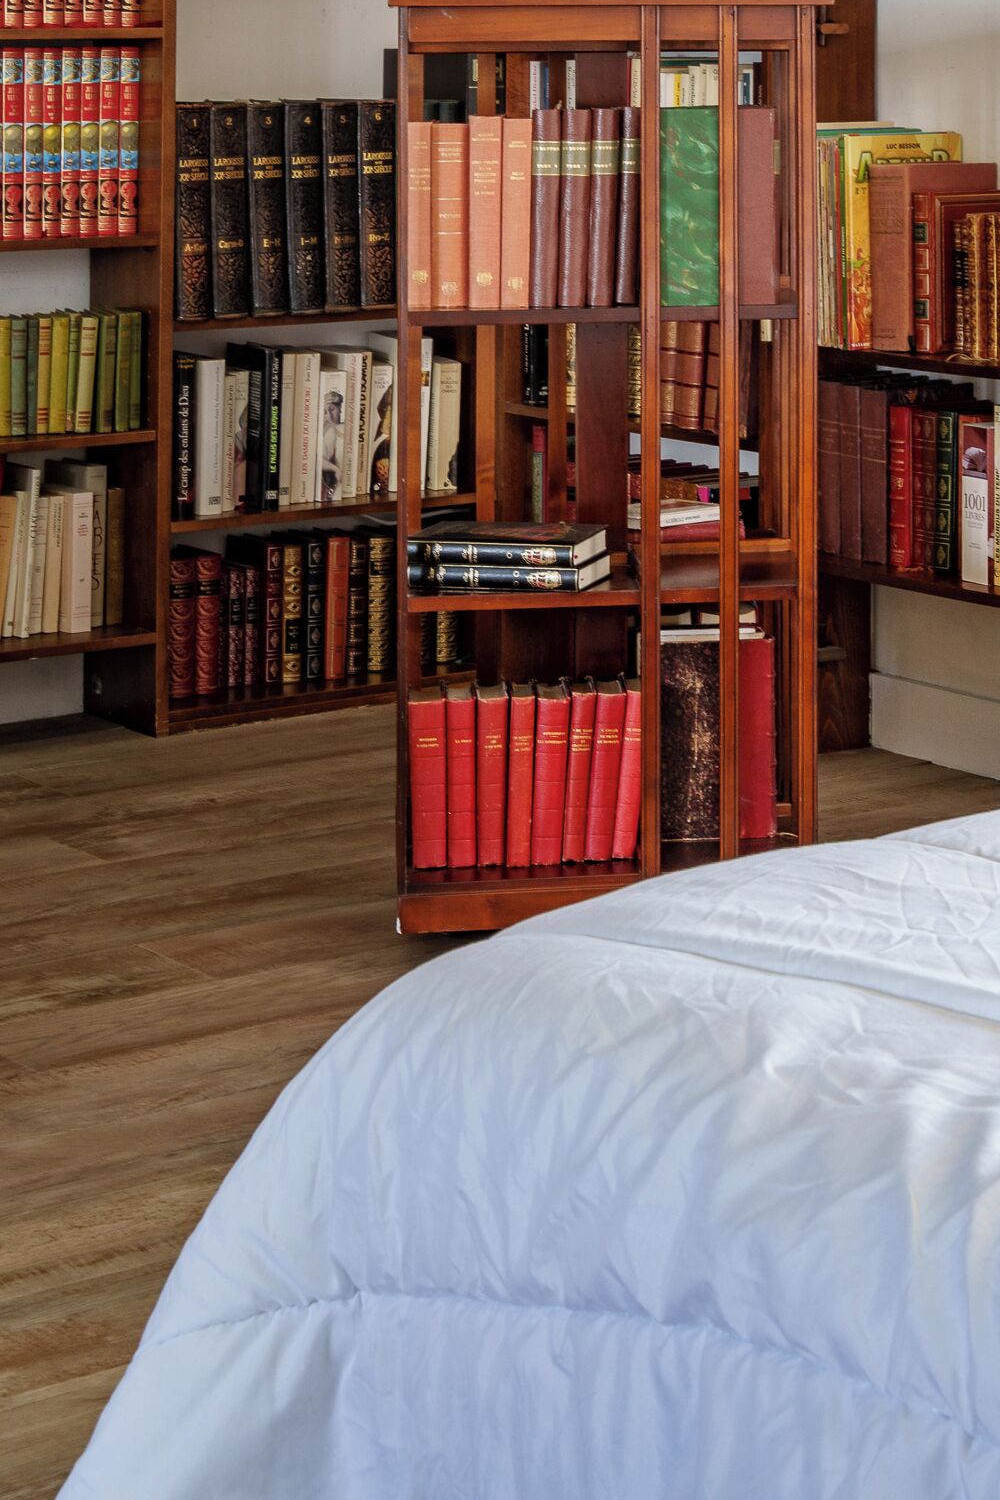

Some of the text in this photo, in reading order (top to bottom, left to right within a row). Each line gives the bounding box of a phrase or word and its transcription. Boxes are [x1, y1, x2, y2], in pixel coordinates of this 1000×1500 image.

[226, 117, 232, 126] 2
[265, 117, 272, 125] 3
[375, 113, 381, 121] 6
[192, 118, 197, 127] 1
[177, 386, 191, 500] Le camp des enfants de Dieu
[964, 493, 986, 511] 1001
[995, 494, 999, 506] DU
